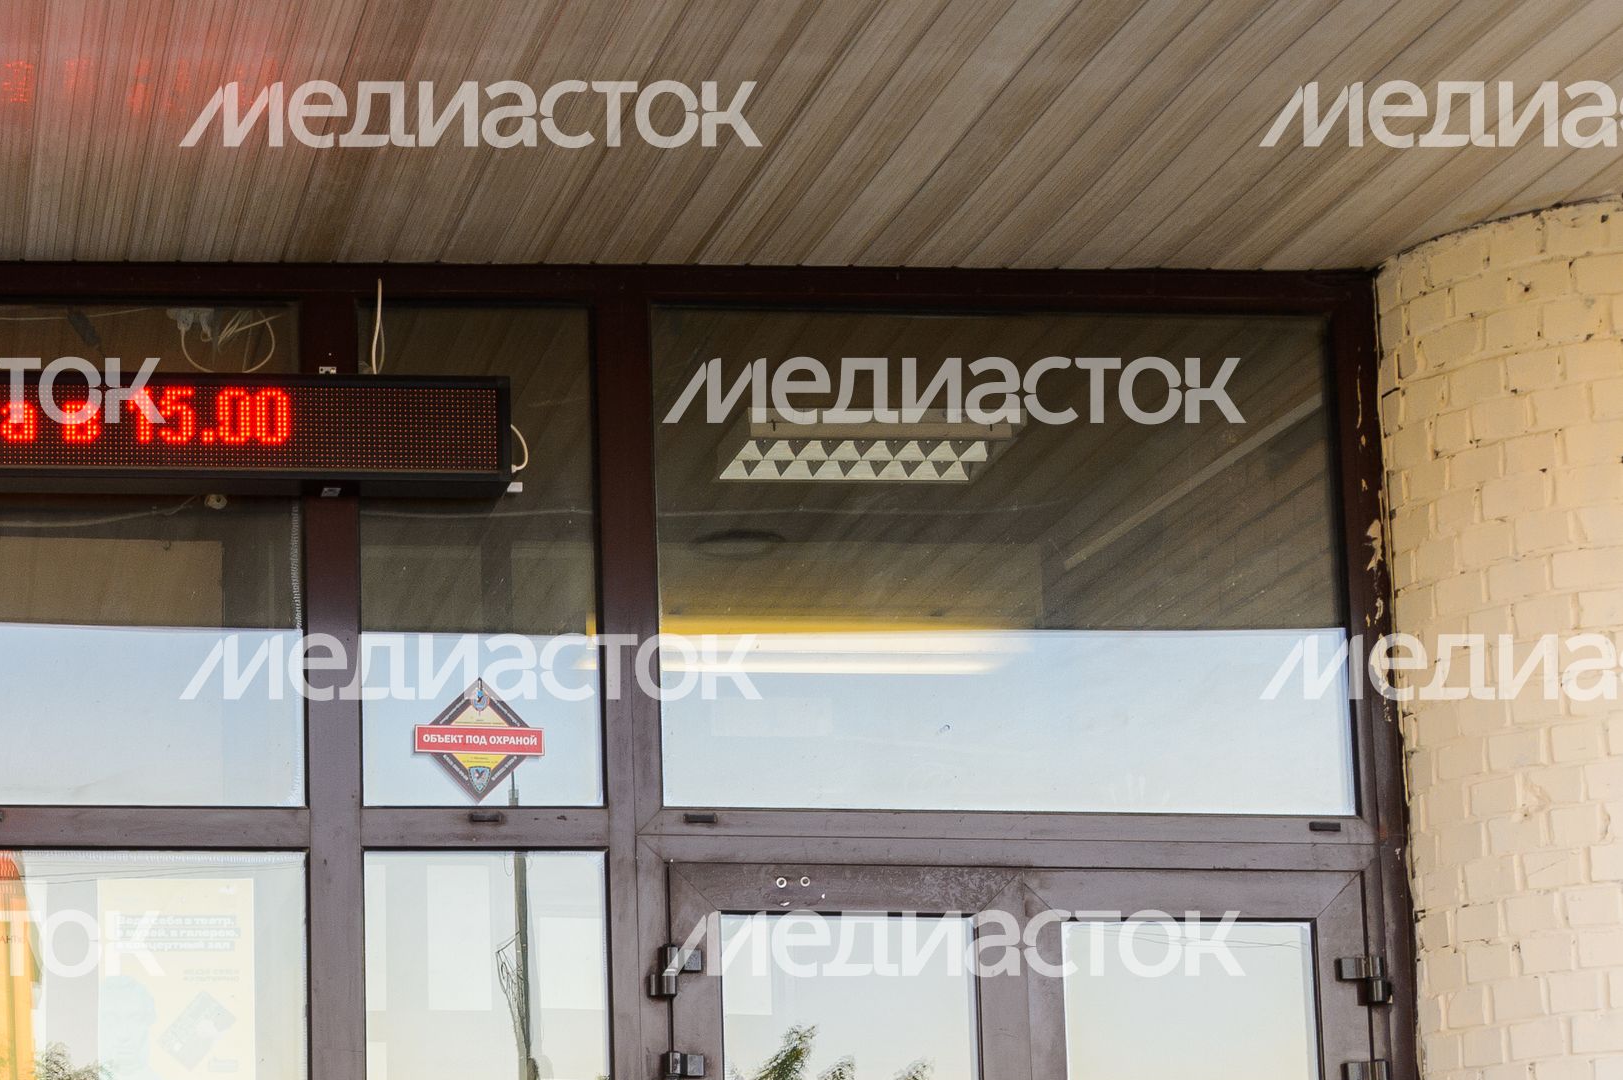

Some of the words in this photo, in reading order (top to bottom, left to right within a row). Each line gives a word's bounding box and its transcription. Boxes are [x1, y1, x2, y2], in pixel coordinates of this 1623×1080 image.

[130, 387, 290, 445] 15.00
[423, 733, 463, 744] ОБЪЕКТ
[466, 735, 487, 746] ПОД
[489, 735, 538, 746] ОХРАНОЙ
